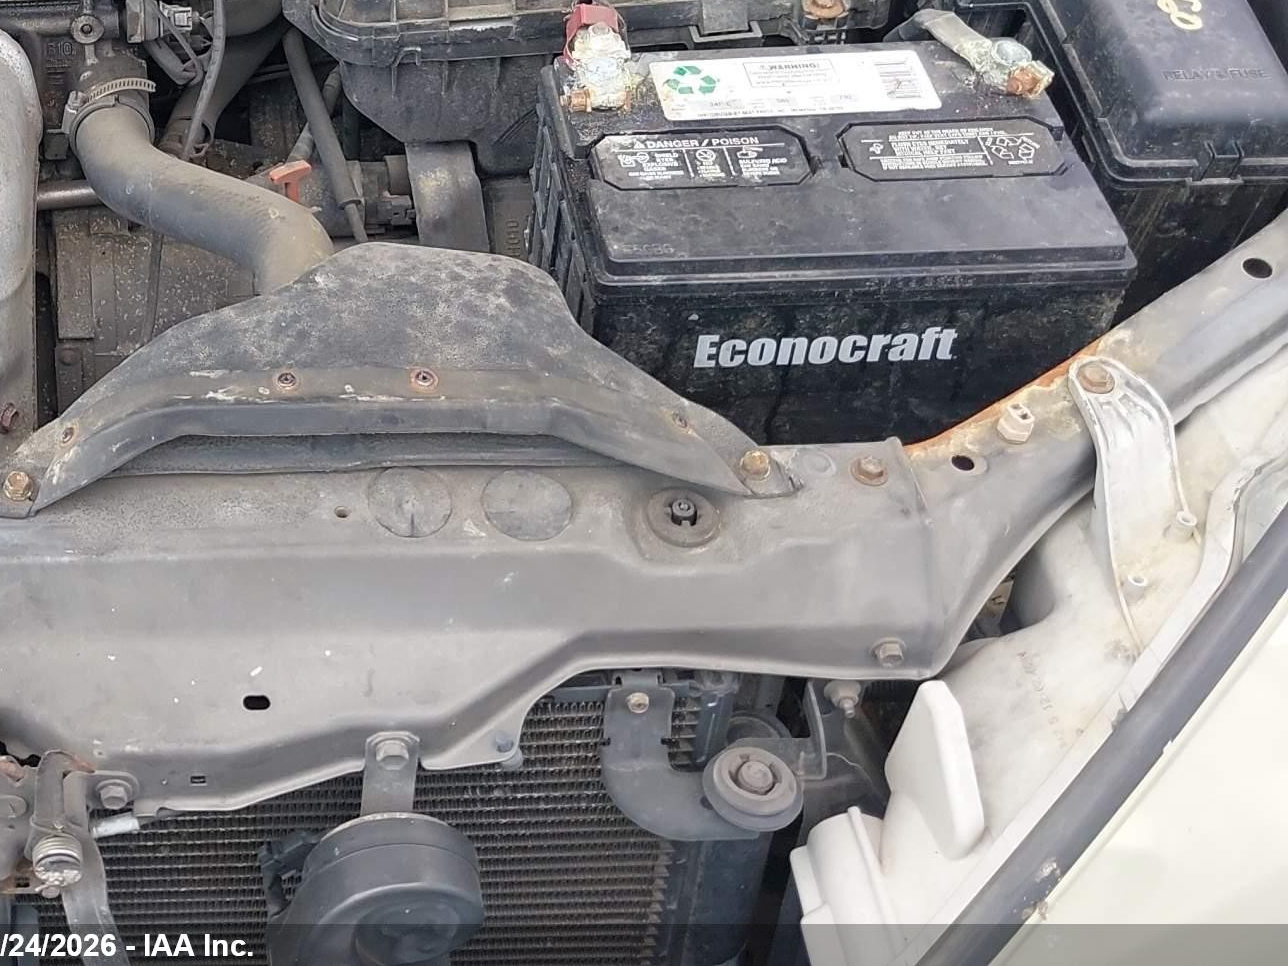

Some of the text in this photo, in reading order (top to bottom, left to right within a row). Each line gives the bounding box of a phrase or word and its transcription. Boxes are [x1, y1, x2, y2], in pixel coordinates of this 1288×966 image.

[646, 139, 699, 149] DANGER
[711, 137, 760, 146] POISON
[693, 327, 958, 368] Econocraft
